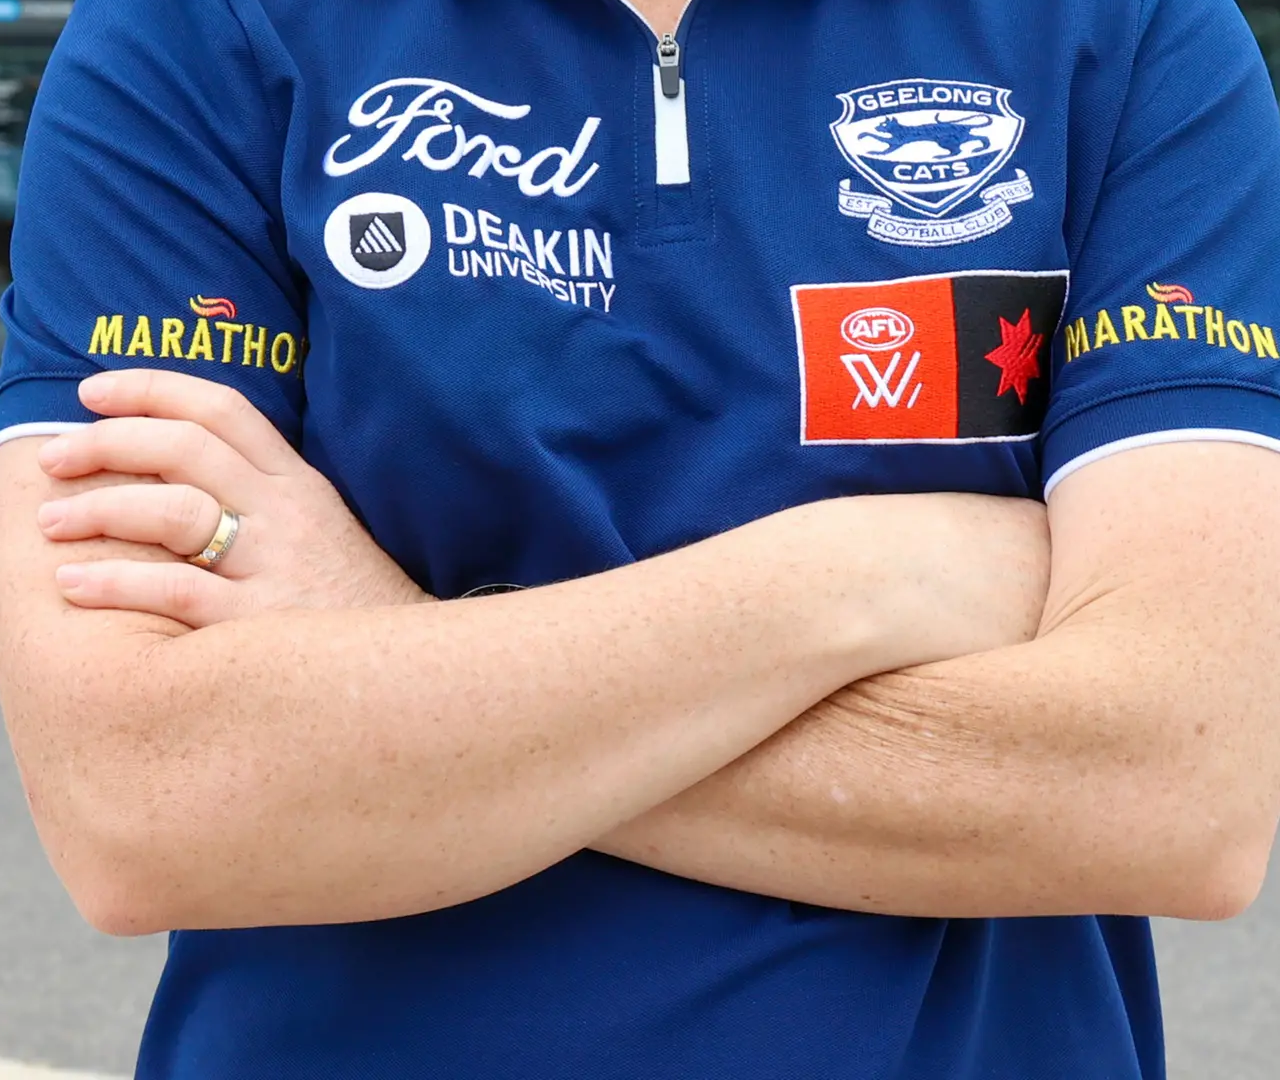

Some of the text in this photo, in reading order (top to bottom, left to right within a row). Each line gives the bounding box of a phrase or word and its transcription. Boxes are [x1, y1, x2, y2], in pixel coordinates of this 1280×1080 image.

[857, 86, 993, 111] GEELONG
[322, 76, 601, 198] Ford
[892, 161, 971, 181] CATS
[442, 202, 614, 279] DEAKIN
[873, 206, 1006, 238] FOOTBALL CLUB
[448, 248, 616, 313] UNIVERSITY
[87, 314, 307, 378] MARATHO
[849, 318, 907, 339] AFL
[1065, 303, 1280, 363] MARATHON
